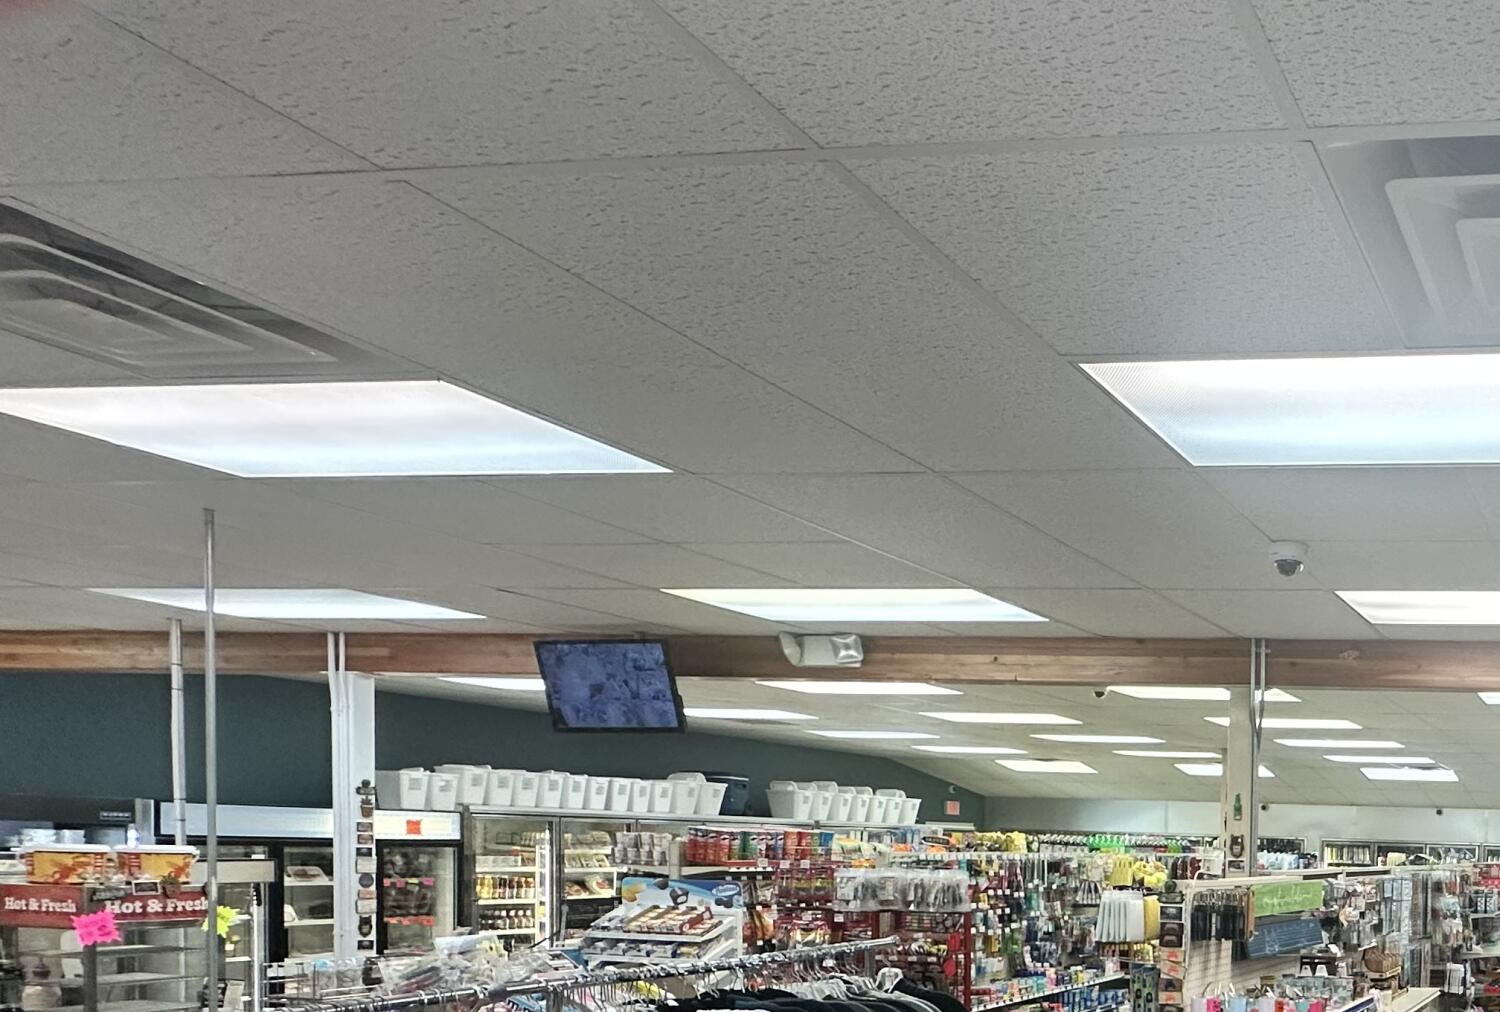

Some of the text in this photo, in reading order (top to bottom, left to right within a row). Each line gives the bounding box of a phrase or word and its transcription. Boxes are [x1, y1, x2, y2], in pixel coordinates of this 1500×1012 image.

[4, 896, 77, 913] Hot & Fresh
[104, 897, 208, 913] Hot & Fresh
